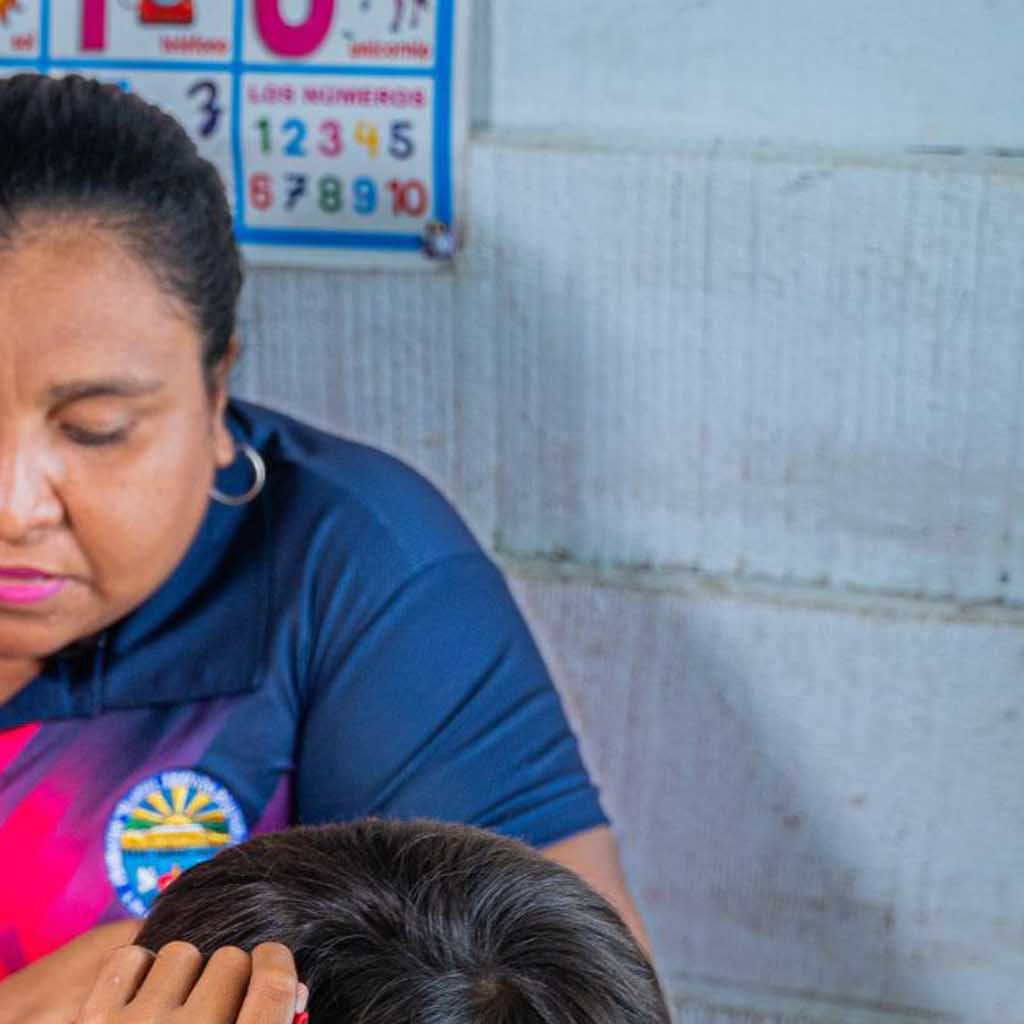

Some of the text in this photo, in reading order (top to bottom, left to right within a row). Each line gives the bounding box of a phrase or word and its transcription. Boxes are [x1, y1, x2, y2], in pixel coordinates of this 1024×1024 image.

[248, 84, 293, 104] LOS
[255, 115, 414, 160] 1 2 3 4 5
[249, 172, 427, 217] 6 7 8 9 10
